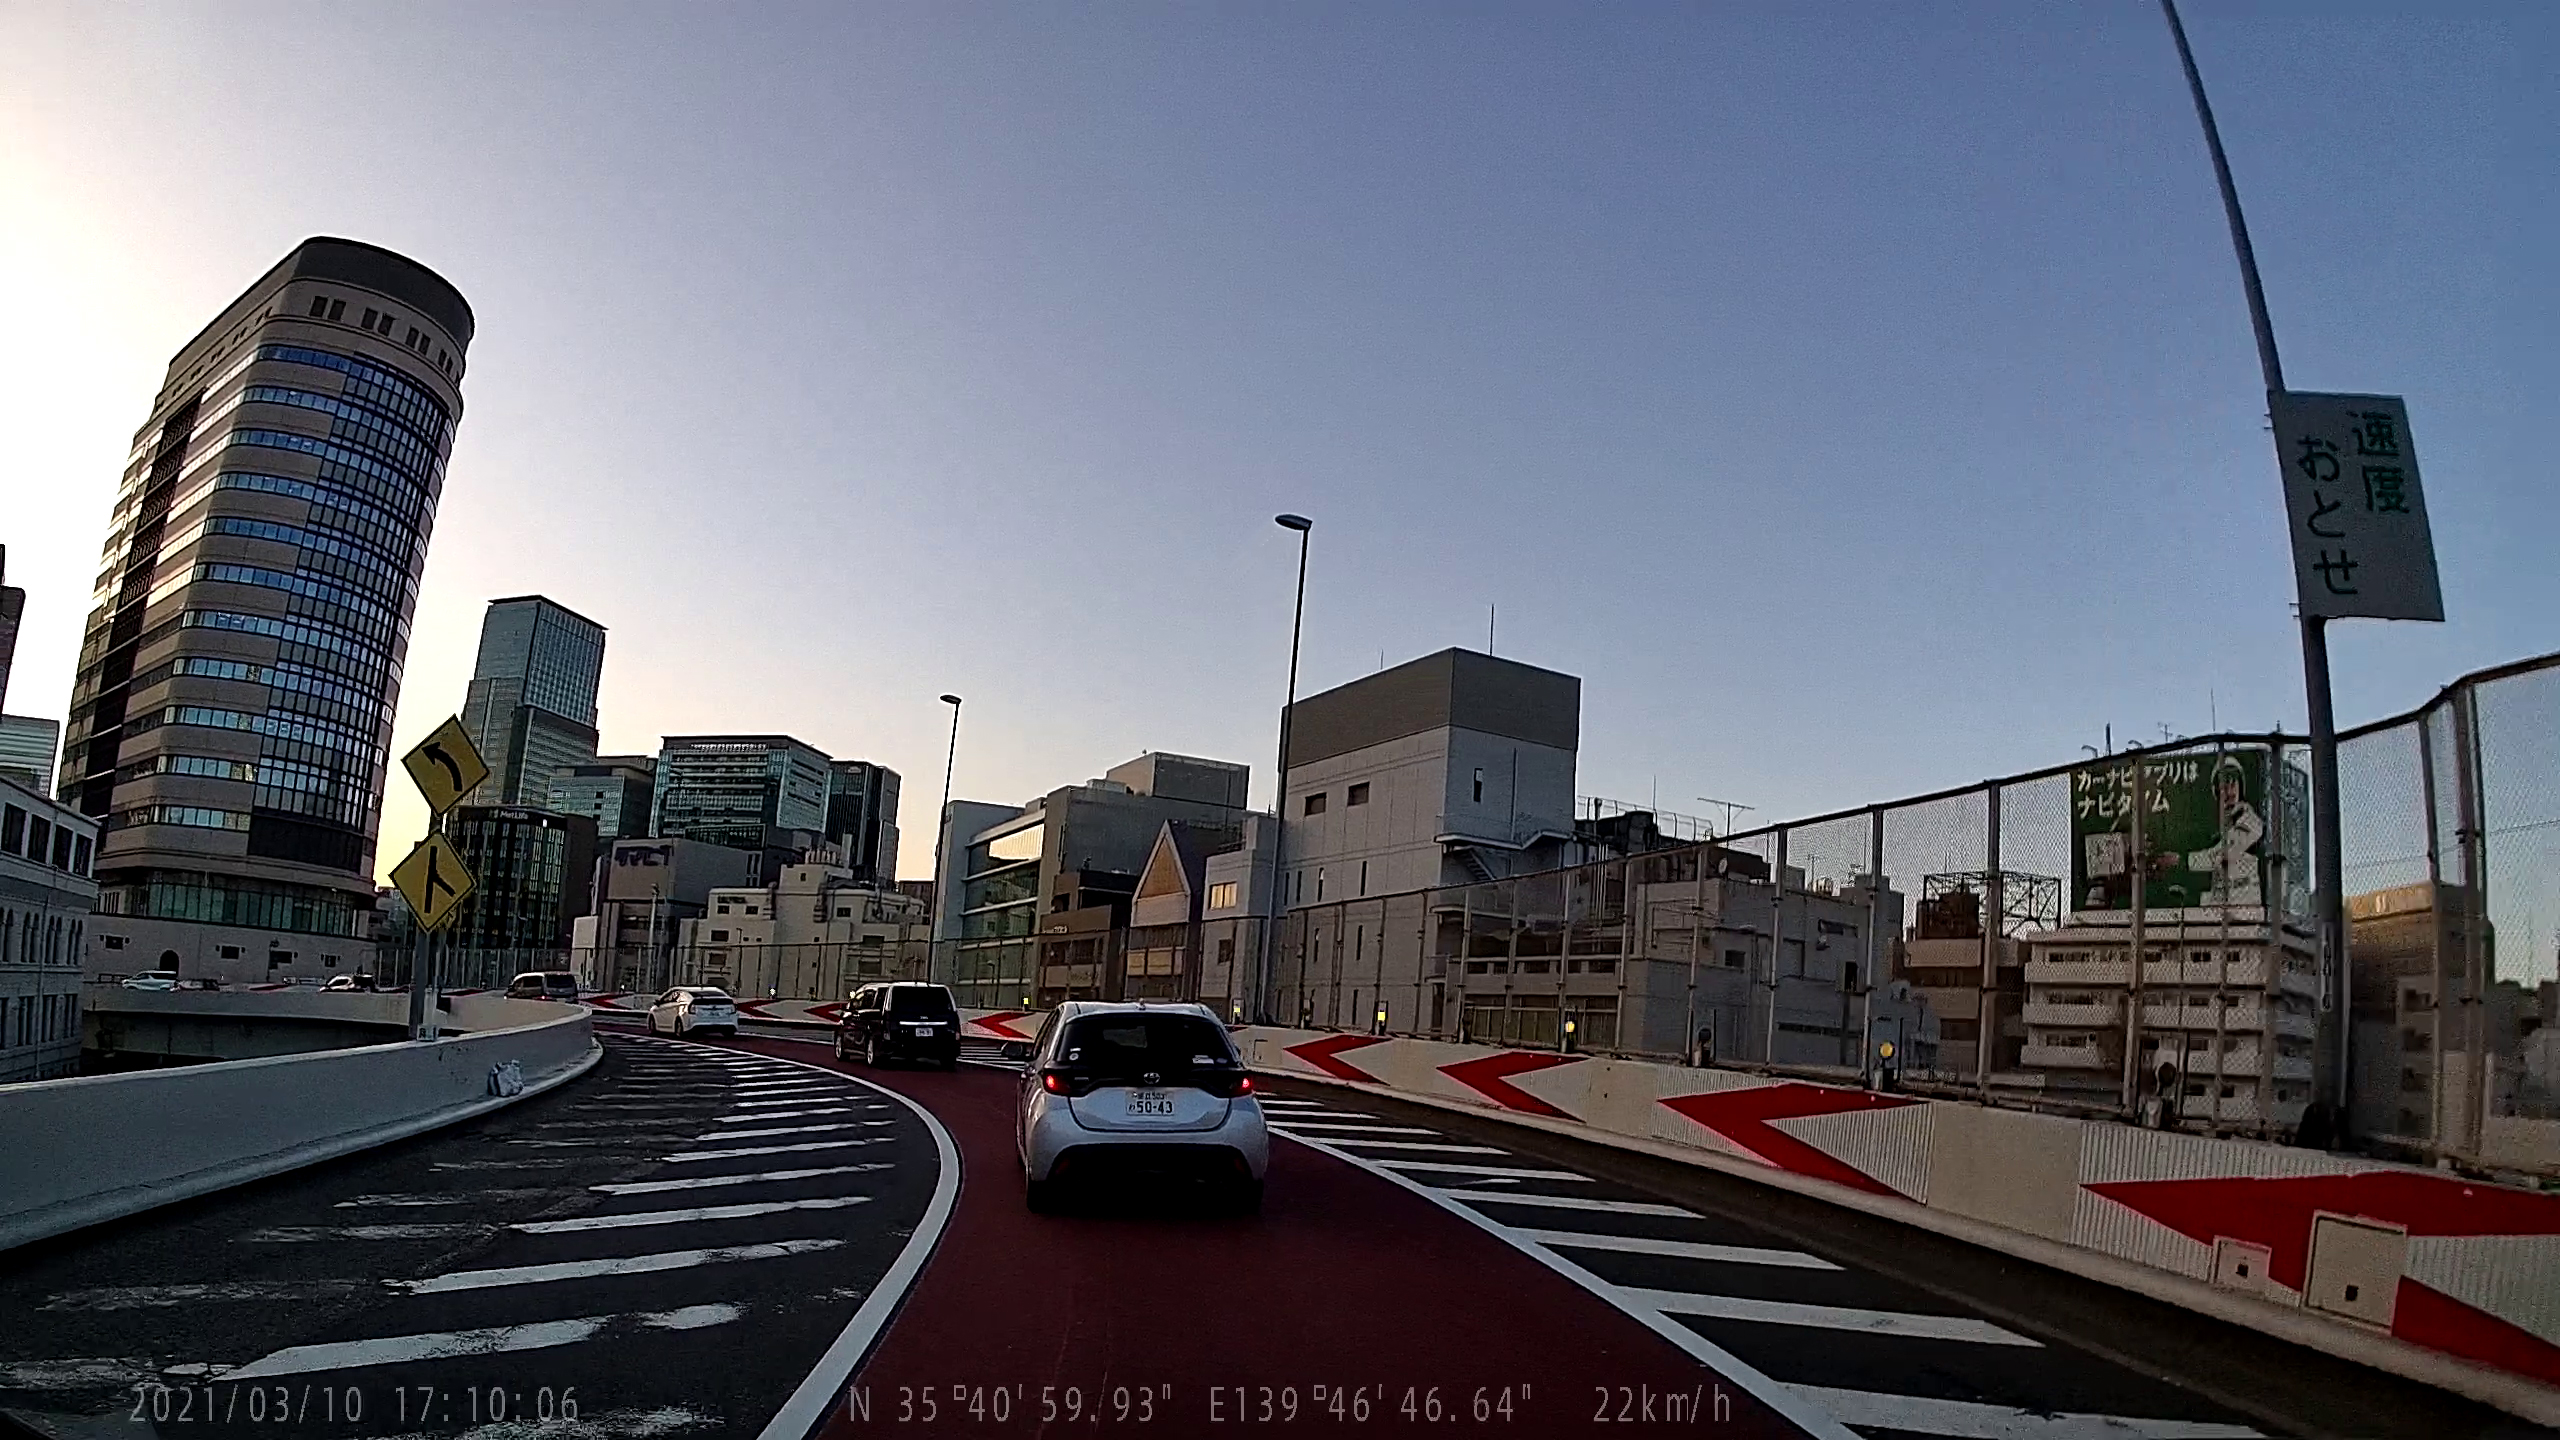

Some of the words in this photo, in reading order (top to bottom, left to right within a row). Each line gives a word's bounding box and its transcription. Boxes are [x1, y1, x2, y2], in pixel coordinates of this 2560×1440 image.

[2296, 435, 2359, 595] おとせ
[2345, 410, 2410, 514] 速度
